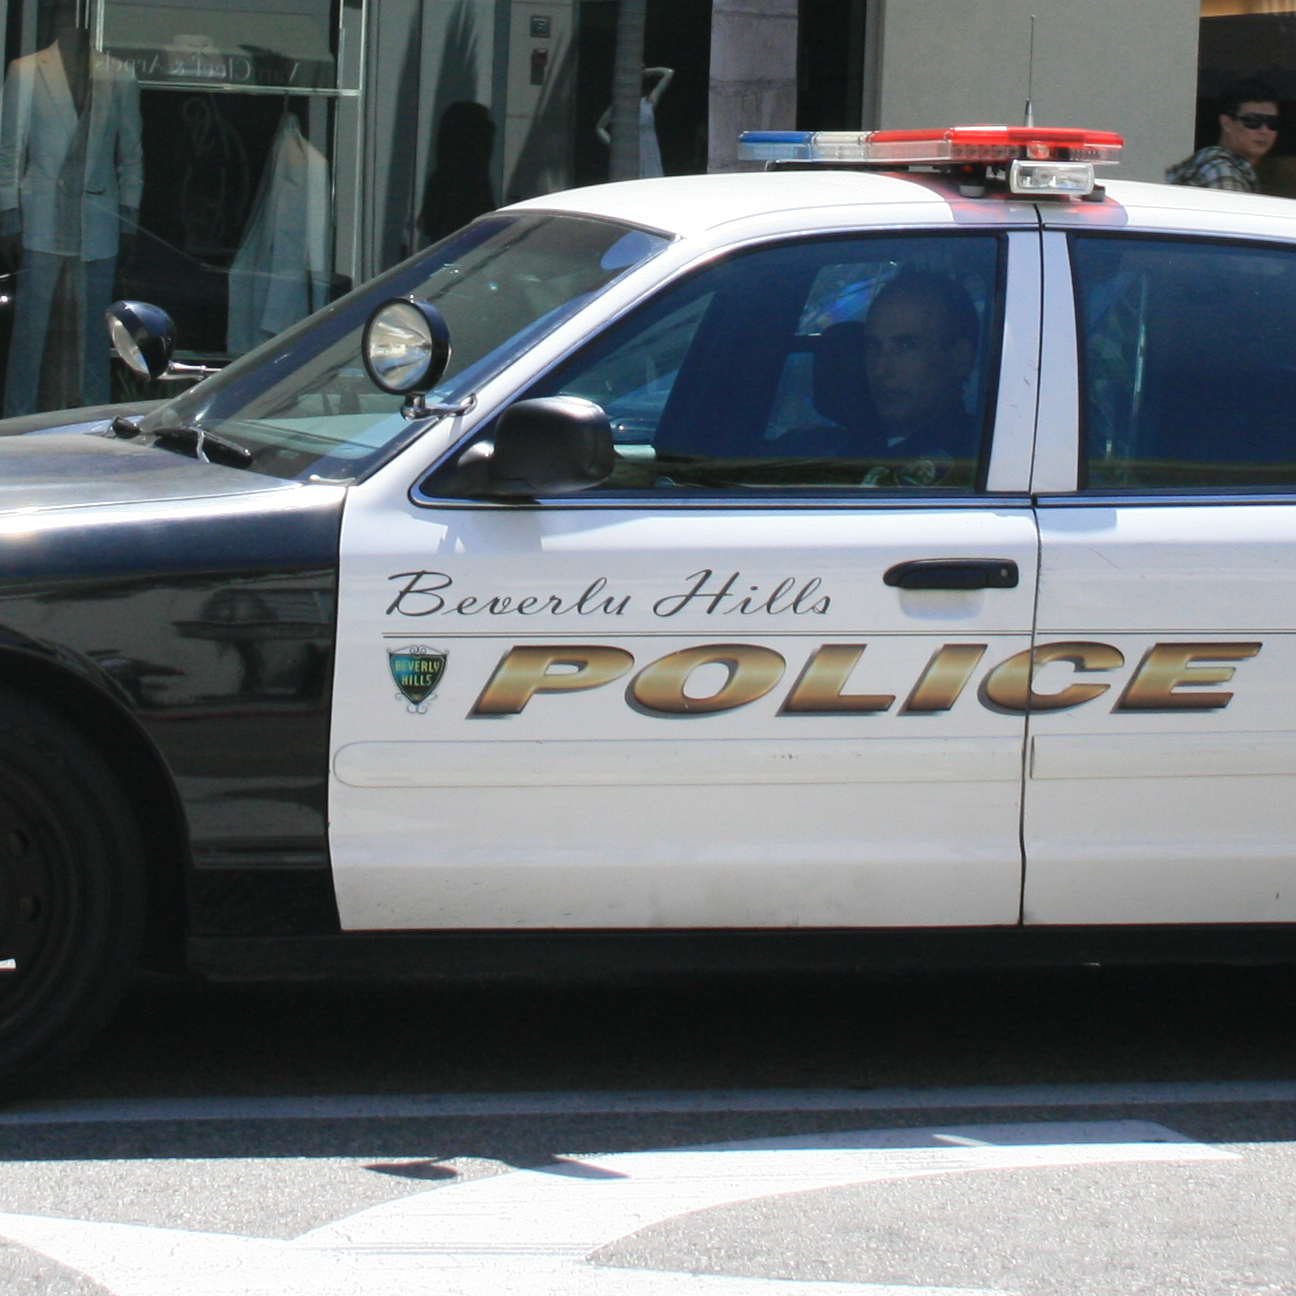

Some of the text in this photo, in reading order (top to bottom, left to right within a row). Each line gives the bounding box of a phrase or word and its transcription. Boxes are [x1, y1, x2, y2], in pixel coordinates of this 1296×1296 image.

[652, 568, 832, 618] Hills
[394, 660, 441, 673] BEVERLY
[401, 674, 432, 687] HILLS
[464, 641, 1264, 720] POLICE
